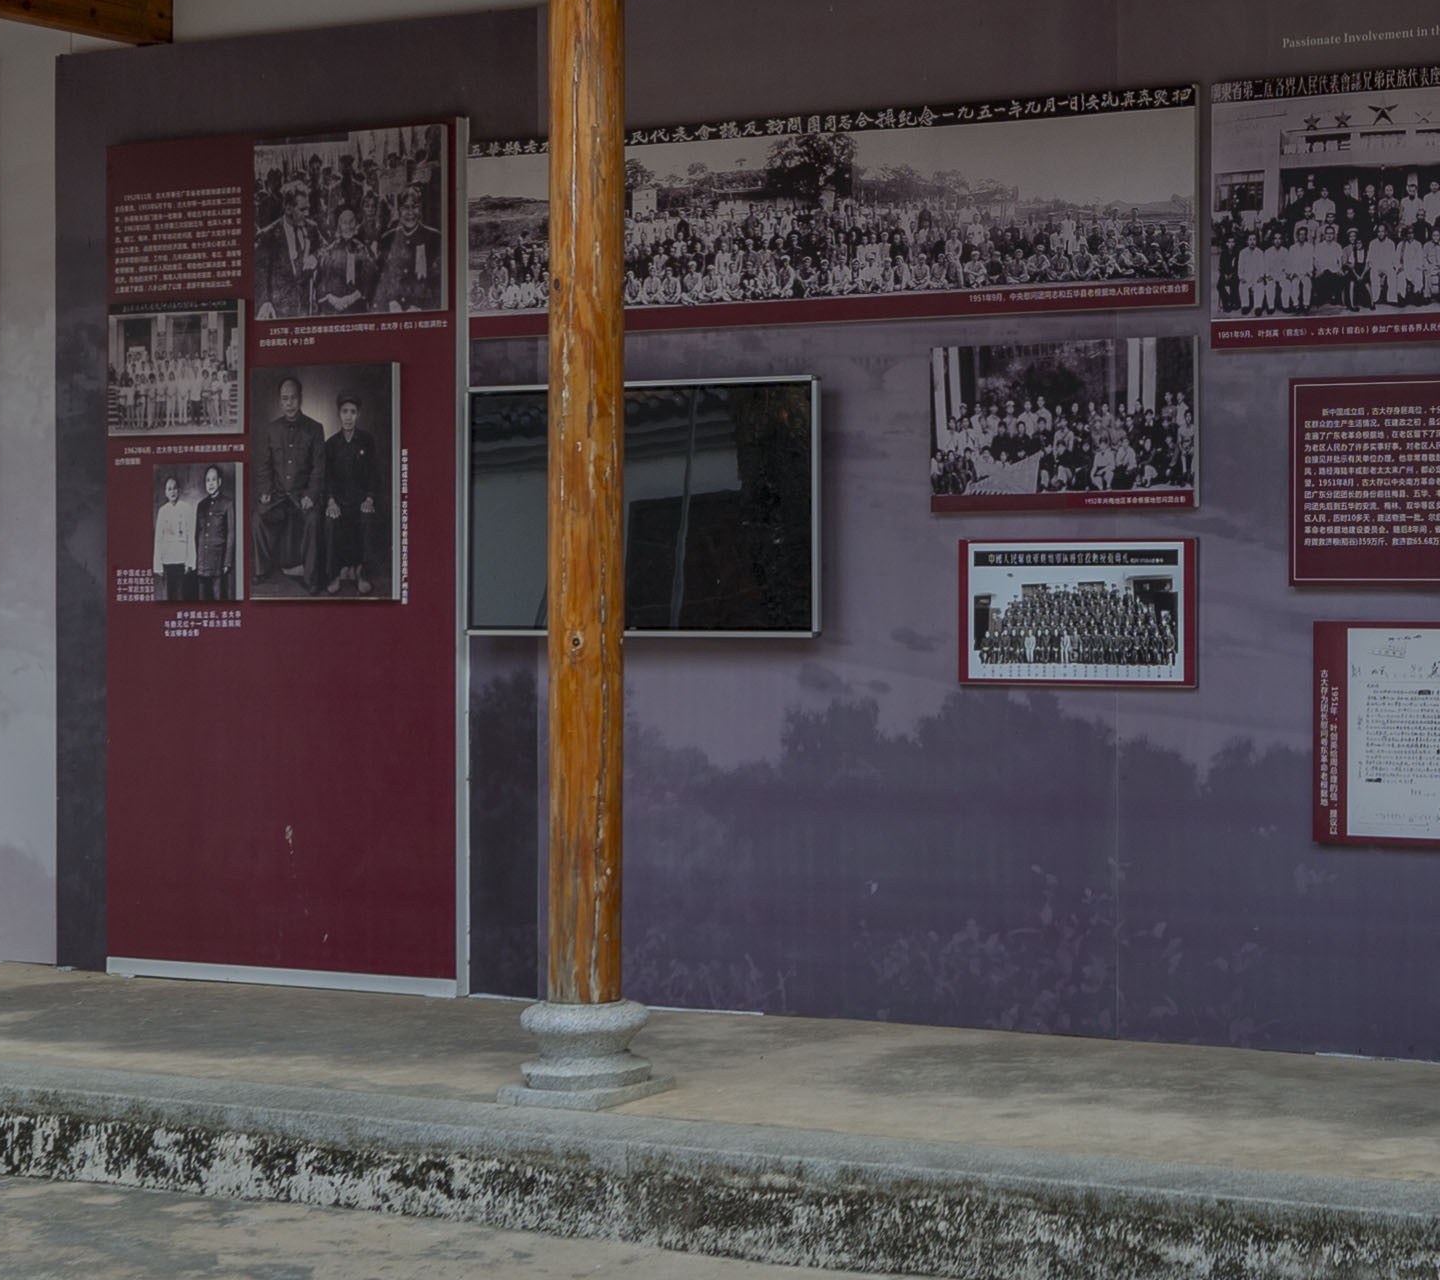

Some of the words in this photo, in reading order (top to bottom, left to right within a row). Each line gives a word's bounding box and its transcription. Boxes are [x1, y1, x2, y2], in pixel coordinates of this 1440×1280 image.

[1282, 33, 1341, 48] Passionate
[1343, 27, 1414, 44] Involvement
[1417, 27, 1428, 36] in
